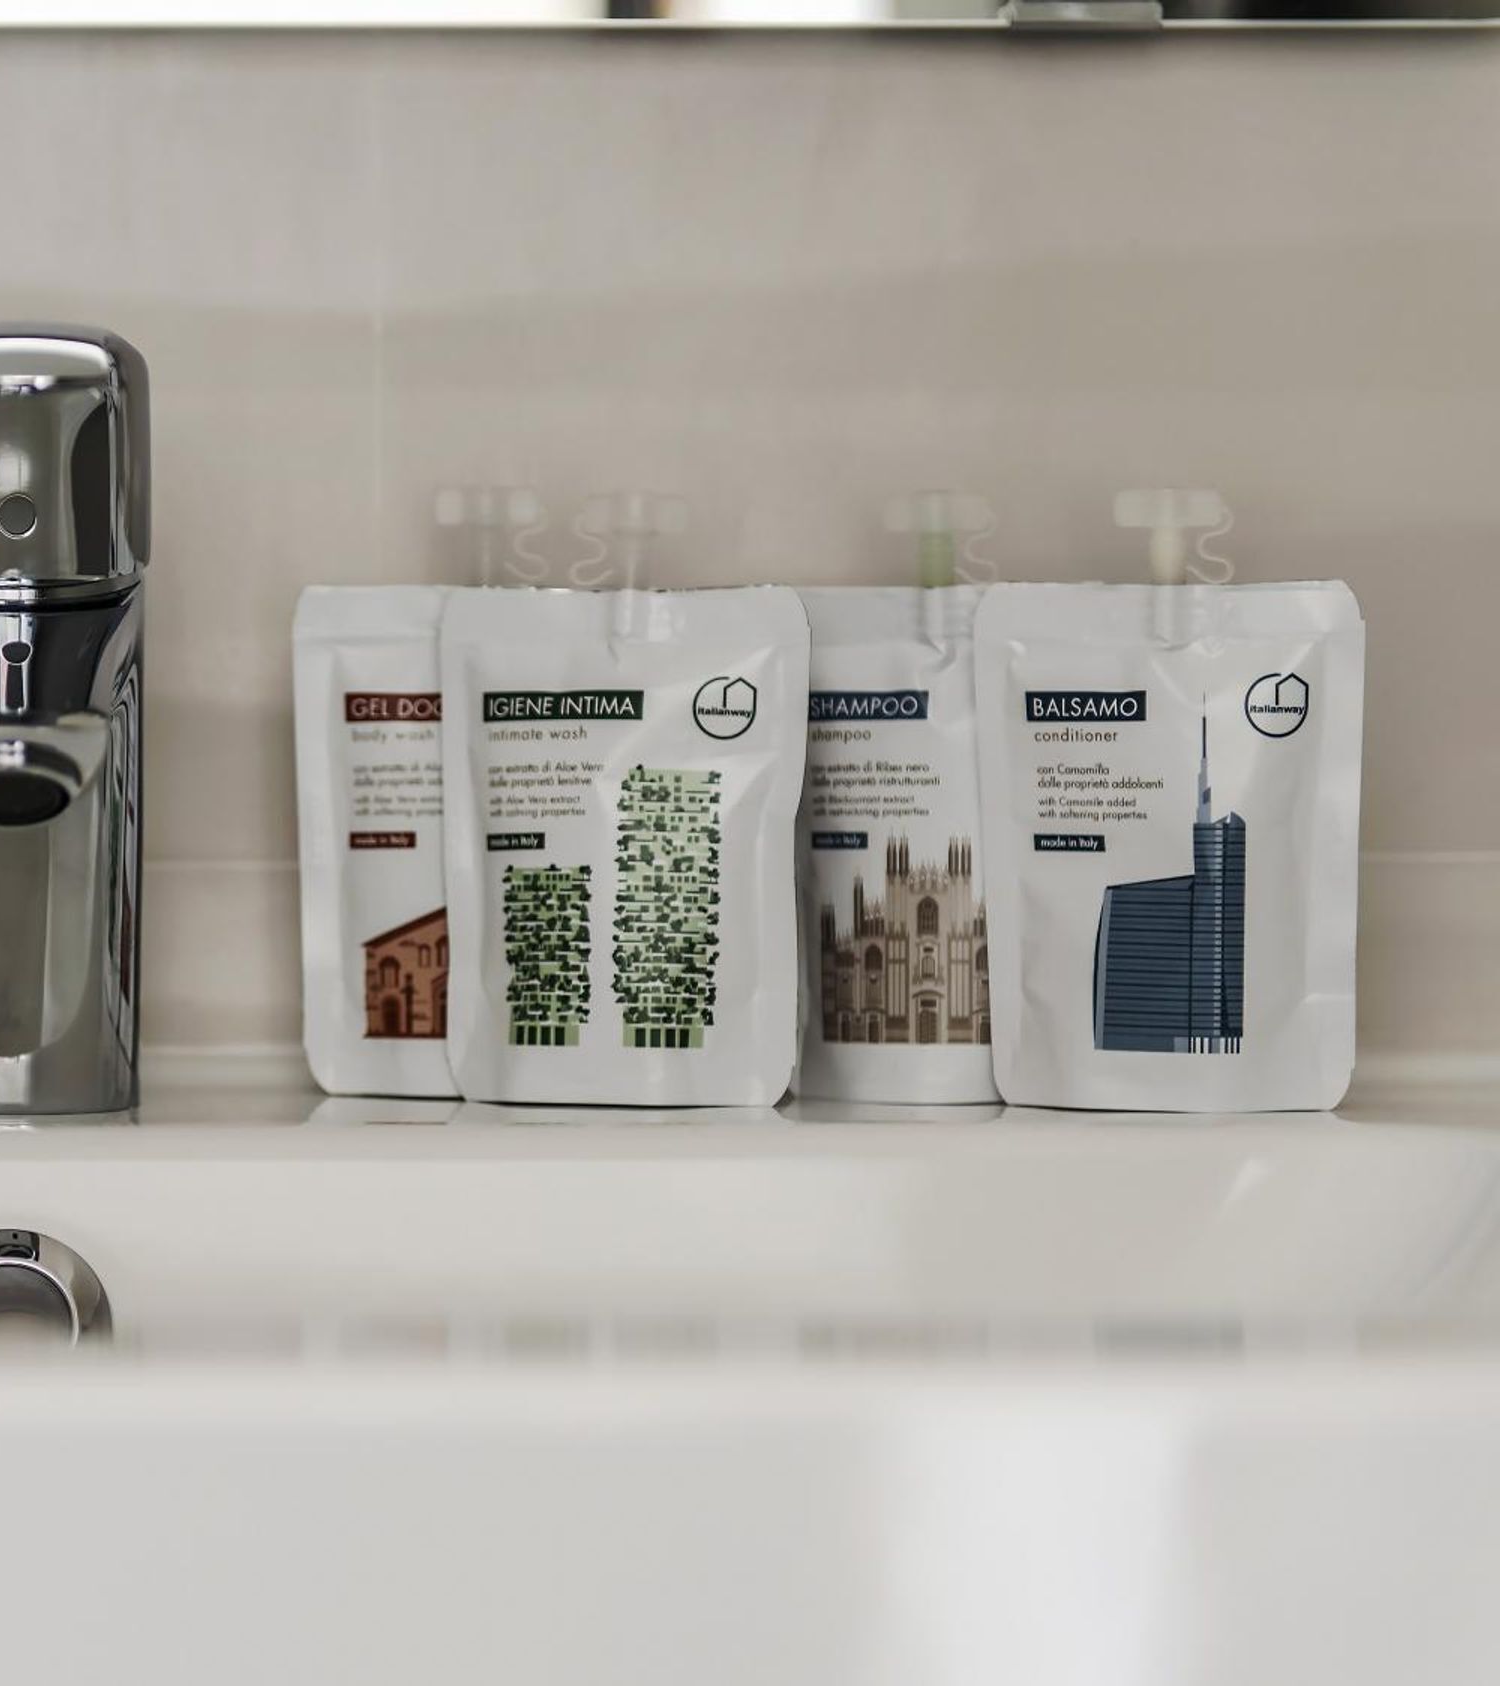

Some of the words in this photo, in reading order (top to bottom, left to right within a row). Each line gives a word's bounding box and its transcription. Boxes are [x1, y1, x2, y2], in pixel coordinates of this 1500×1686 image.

[350, 697, 388, 717] GEL
[489, 697, 554, 717] IGIENE
[560, 696, 635, 716] INTIMA
[697, 706, 752, 718] italianway
[810, 695, 918, 717] SHAMPOO
[1033, 697, 1138, 717] BALSAMO
[1250, 705, 1305, 716] italianway
[489, 728, 543, 742] intimate
[549, 726, 588, 741] wash
[810, 727, 872, 744] shampoo
[1034, 727, 1119, 742] conditioner
[555, 762, 577, 772] Aloe
[580, 761, 603, 772] Vera
[906, 764, 930, 773] nero
[1037, 766, 1054, 775] con
[1057, 763, 1110, 775] Camomilla
[1038, 776, 1061, 789] dalle
[1038, 796, 1057, 806] with
[1106, 797, 1137, 807] added
[1038, 809, 1057, 819] with
[1102, 810, 1148, 822] properties
[520, 834, 539, 848] Italy
[1040, 835, 1067, 847] made
[1068, 837, 1077, 847] in
[1078, 836, 1099, 850] Italy
